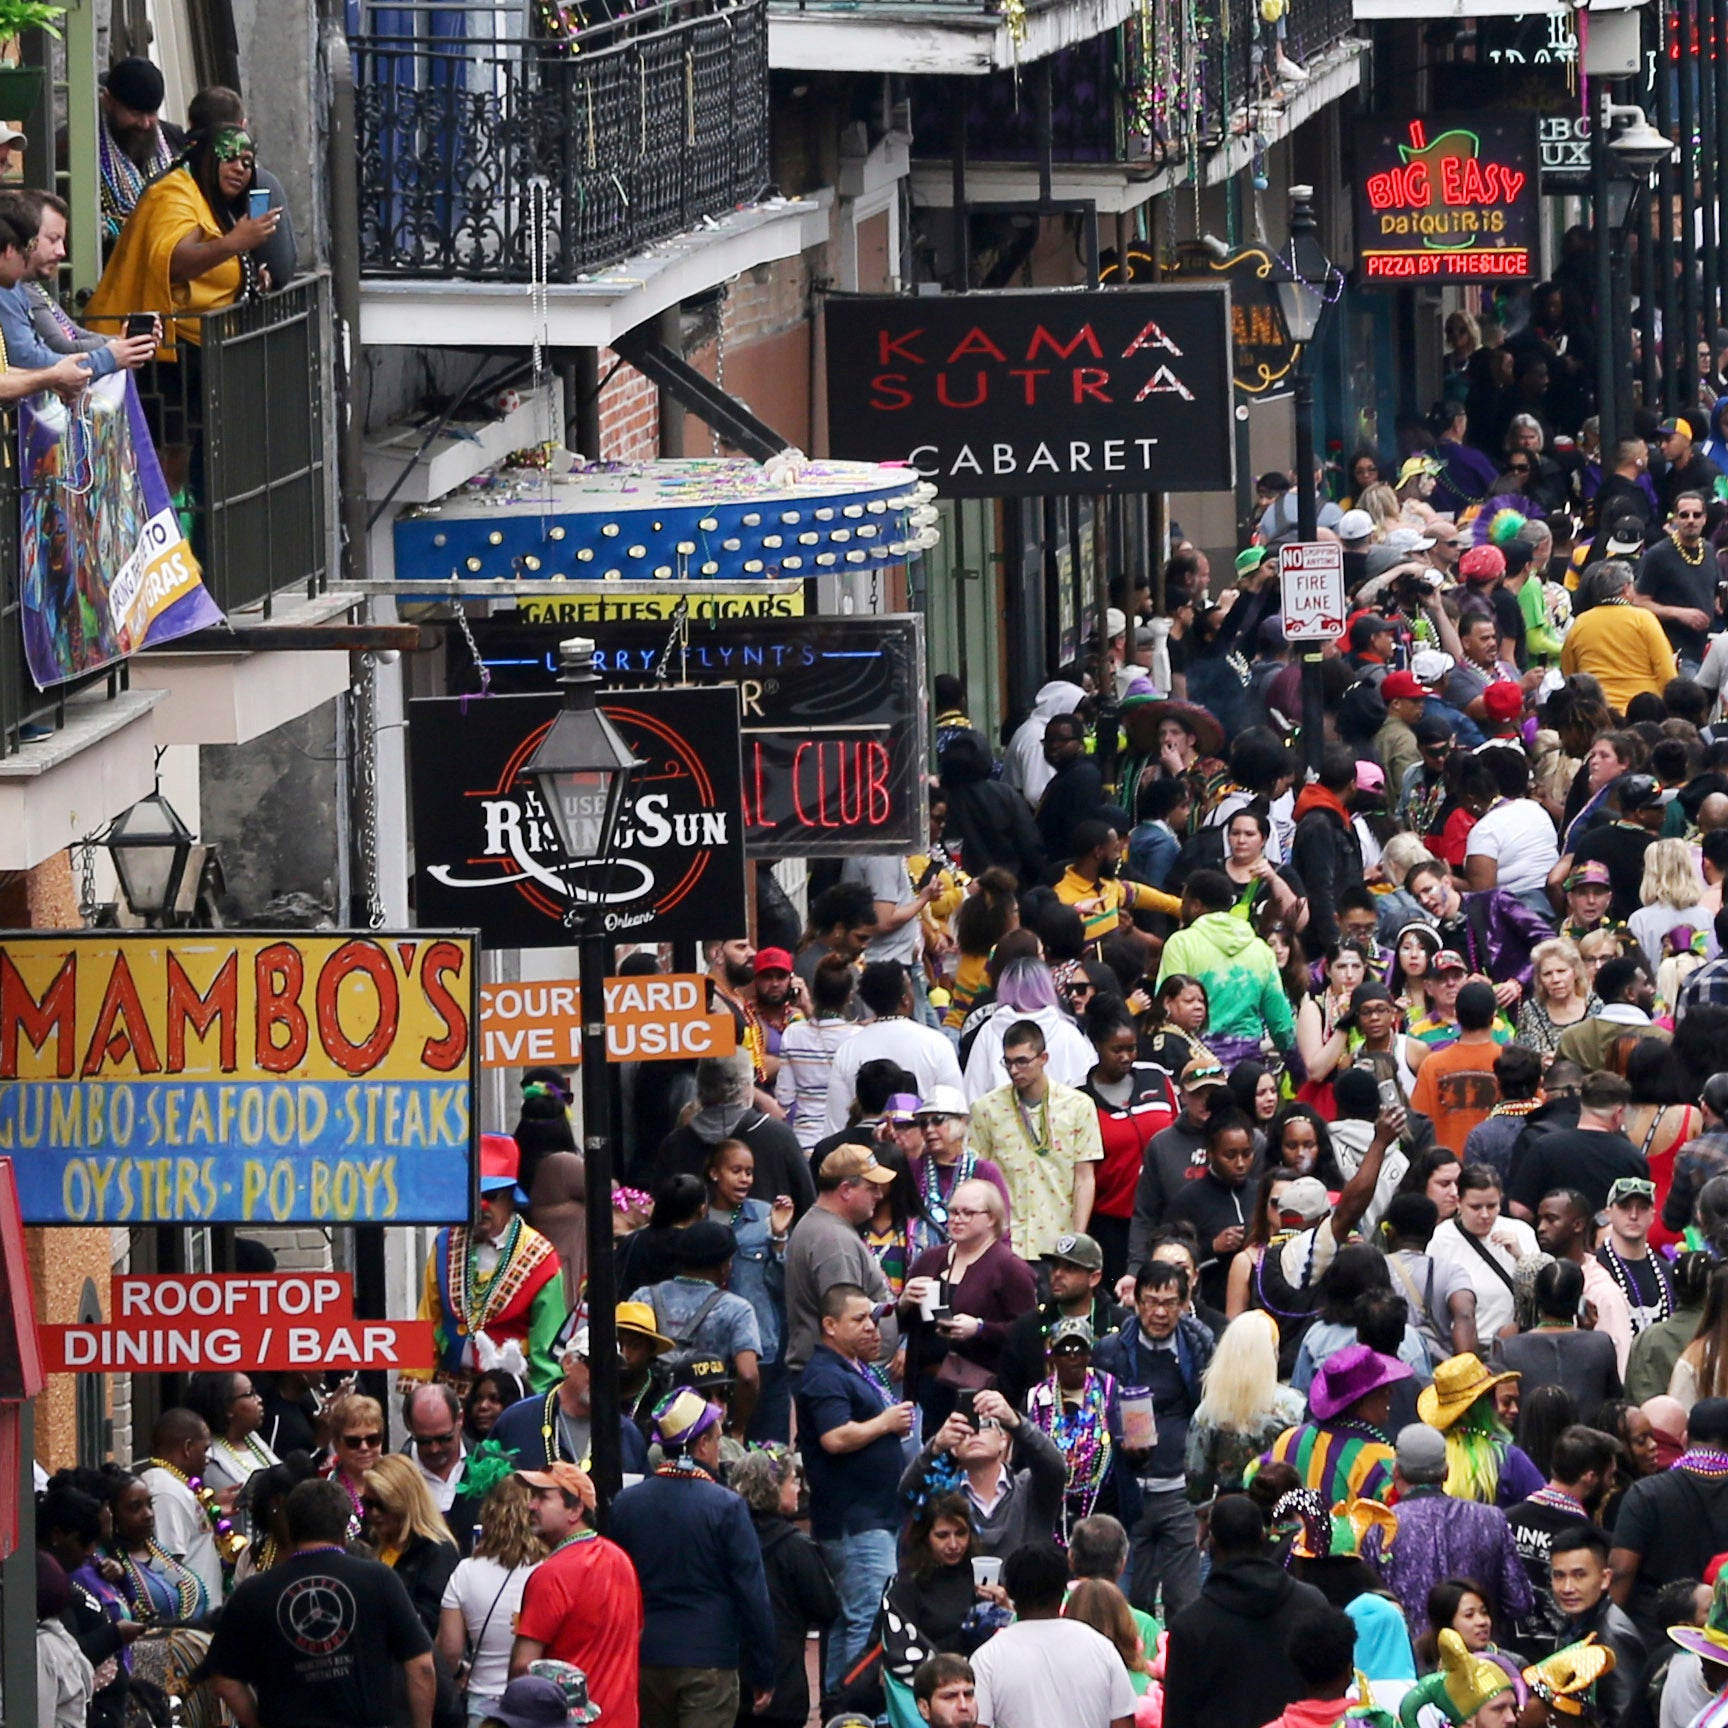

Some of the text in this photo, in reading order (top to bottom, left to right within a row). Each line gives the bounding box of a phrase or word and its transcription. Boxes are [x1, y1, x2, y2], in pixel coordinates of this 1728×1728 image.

[1367, 156, 1525, 209] BIG EASY
[1367, 255, 1416, 276] PIZZA
[1418, 255, 1441, 275] BY
[877, 319, 1184, 366] KAMA
[869, 364, 1196, 411] SUTRA
[907, 438, 1159, 478] CABARET
[145, 523, 167, 551] TO
[1284, 549, 1303, 568] NO
[1297, 575, 1328, 591] FIRE
[1296, 595, 1331, 611] LANE
[545, 650, 656, 672] LRRY
[792, 741, 891, 828] CLUB
[480, 982, 700, 1020] COURYARD
[344, 1083, 470, 1147] STEAKS
[62, 1155, 218, 1222] OYSTERS
[122, 1278, 342, 1317] ROOFTOP
[64, 1329, 243, 1366] DINING
[288, 1326, 399, 1364] BAR
[692, 1361, 710, 1376] TOP
